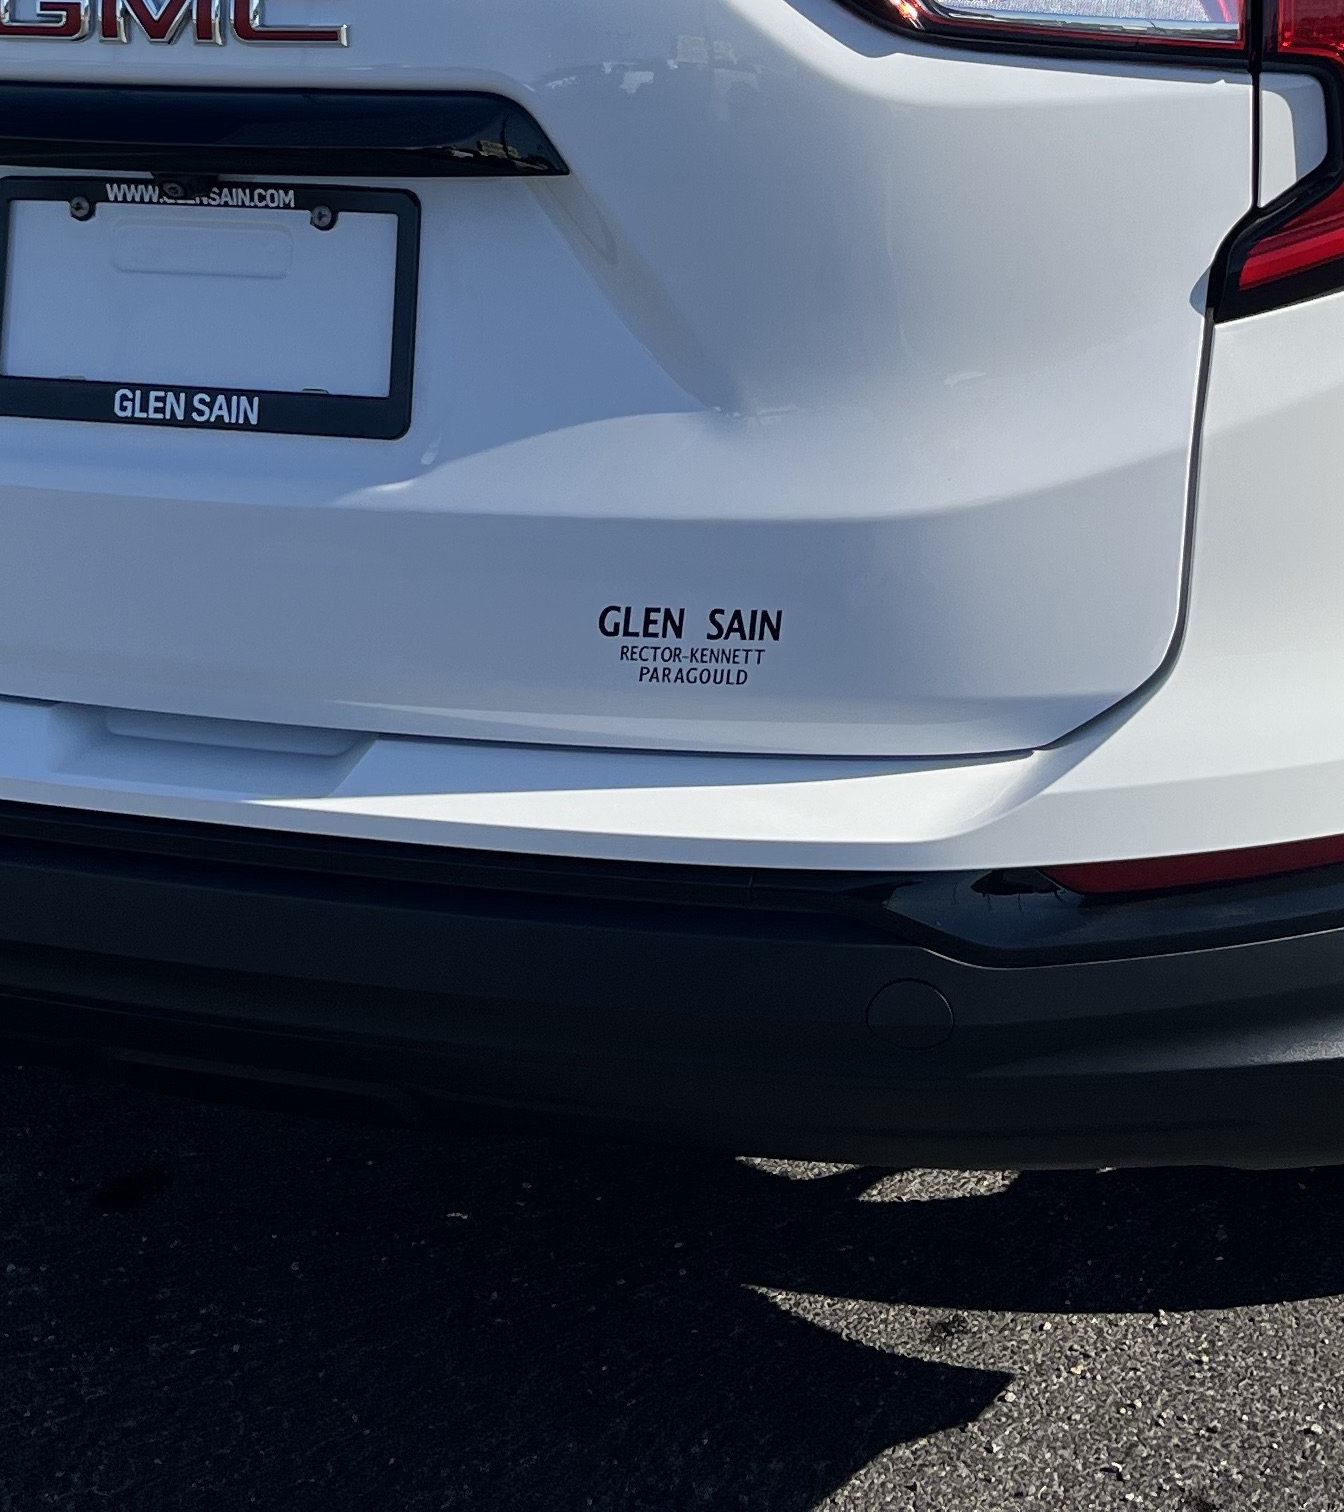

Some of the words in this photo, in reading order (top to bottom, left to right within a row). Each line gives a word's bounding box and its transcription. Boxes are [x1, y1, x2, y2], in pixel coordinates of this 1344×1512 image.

[106, 183, 295, 208] WWW.SAIN.COM
[113, 389, 187, 420] GLEN
[191, 396, 260, 425] SAIN
[598, 605, 685, 639] GLEN
[706, 608, 783, 641] SAIN
[619, 645, 765, 665] RECTOR-KENNETT
[638, 666, 748, 685] PARAGOULD
